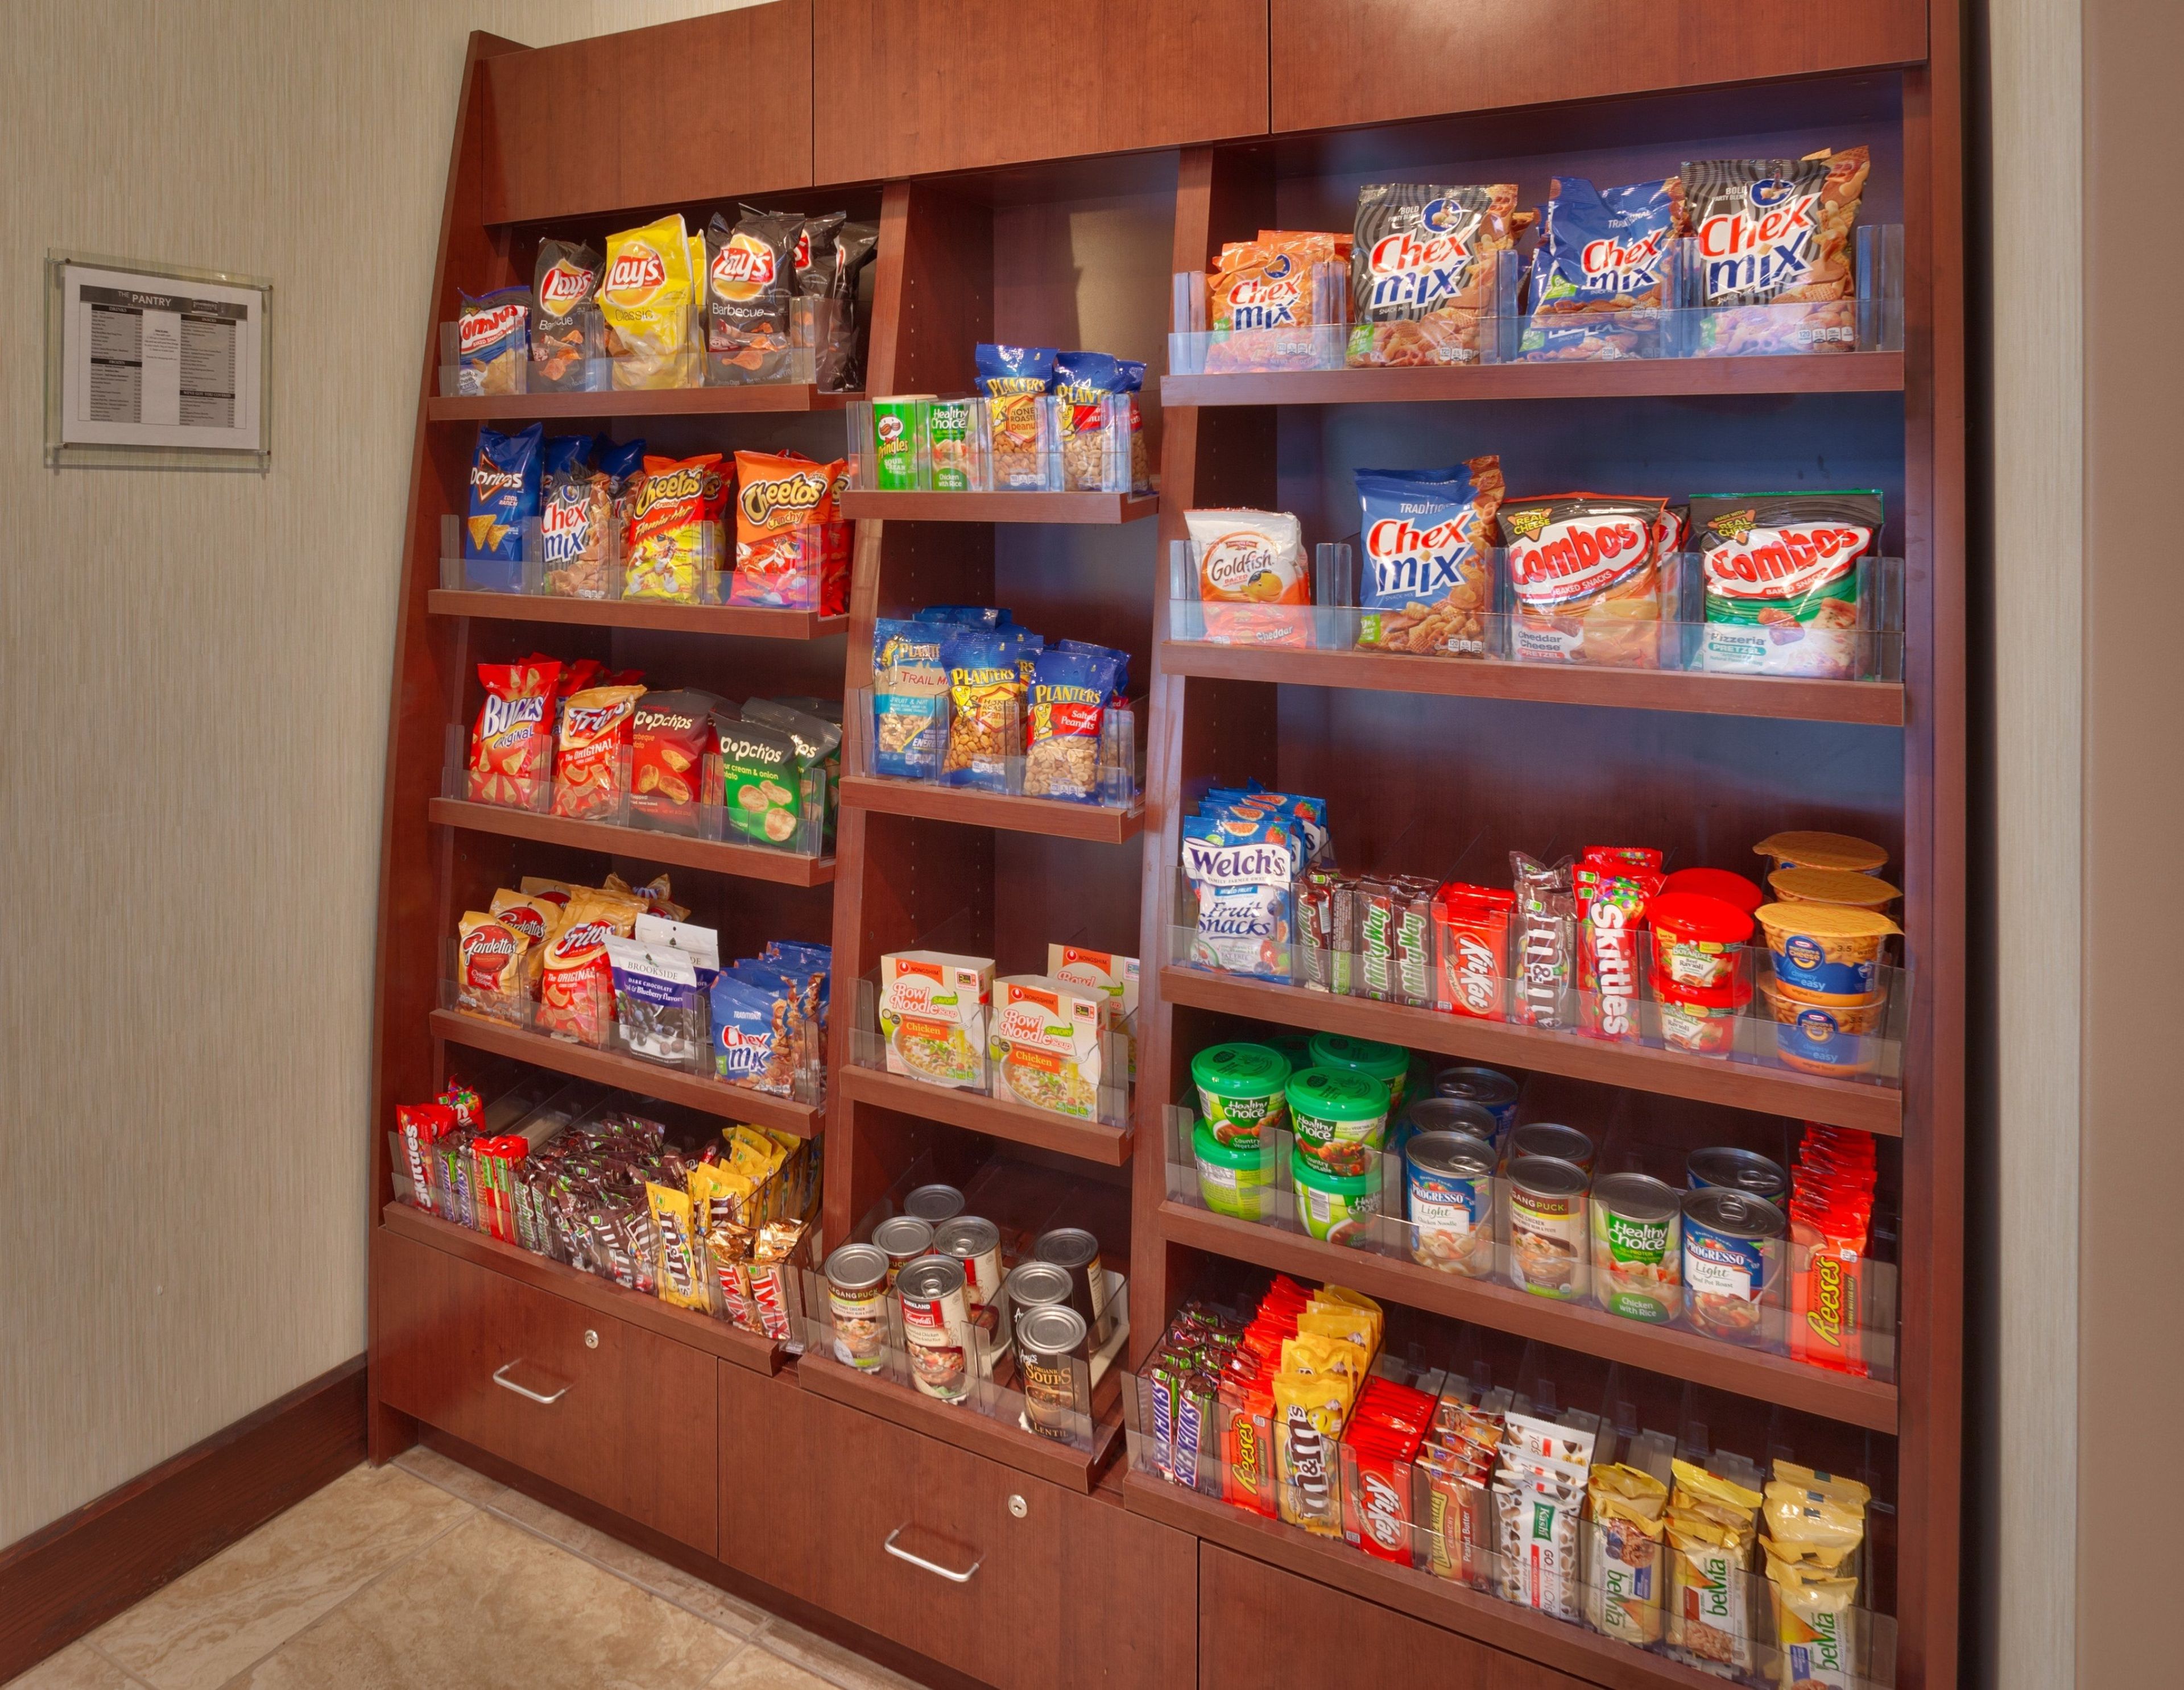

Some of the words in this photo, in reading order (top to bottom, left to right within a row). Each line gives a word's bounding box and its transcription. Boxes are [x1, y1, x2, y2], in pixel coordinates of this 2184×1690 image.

[1725, 185, 1748, 195] BOLD
[1399, 205, 1420, 216] BOLD
[1700, 197, 1813, 257] Chex
[1372, 219, 1480, 274] Chex
[1583, 230, 1663, 274] Chex
[713, 249, 771, 283] Lay's
[1709, 230, 1810, 293] mix
[607, 256, 660, 291] Lay's
[1373, 259, 1467, 305] mix
[1589, 256, 1662, 290] mix
[544, 268, 593, 301] Lay's
[1228, 273, 1302, 305] Chex
[132, 294, 172, 307] PANTRY
[712, 303, 765, 317] Barbecue
[615, 308, 653, 322] Classic
[1235, 293, 1301, 331] mix
[987, 378, 1046, 397] PLANTERS
[933, 406, 969, 420] Healthy
[931, 417, 966, 429] Choice
[878, 437, 909, 464] Pringles
[470, 467, 523, 488] Doritos
[634, 469, 703, 517] Cheetos
[743, 473, 825, 524] Cheetos
[655, 500, 679, 508] Crunchy
[541, 499, 589, 533] Chex
[768, 511, 803, 529] Crunchy
[1516, 513, 1544, 526] REAL
[1719, 517, 1751, 529] REAL
[1729, 510, 1745, 518] WITH
[1369, 513, 1469, 557] Chex
[1513, 518, 1551, 535] CHEESE
[545, 525, 588, 560] mix
[1509, 523, 1639, 585] Combos
[1711, 529, 1860, 583] Combos
[1211, 549, 1272, 582] Goldfish
[1378, 548, 1466, 594] mix
[1224, 574, 1248, 584] BAKED
[1554, 585, 1581, 595] BAKED
[1583, 571, 1613, 590] SNACKS
[1256, 626, 1293, 641] Cheddar
[1518, 630, 1562, 643] Cheddar
[1710, 632, 1765, 646] Pizzeria
[1520, 640, 1561, 651] Cheese
[1521, 649, 1561, 658] PRETZEL
[1713, 644, 1760, 655] PRETZEL
[901, 671, 935, 686] TRAIL
[952, 668, 1015, 685] PLANTERS
[1035, 685, 1101, 705] PLANTERS
[633, 711, 693, 731] popchips
[1061, 716, 1095, 731] Peanuts
[1072, 710, 1098, 721] Salted
[574, 739, 613, 761] ORIGINAL
[721, 736, 782, 764] popchips
[732, 766, 752, 775] cream
[759, 771, 779, 781] onion
[1188, 847, 1285, 877] Welch's
[1207, 901, 1263, 918] Fruit
[1197, 913, 1271, 936] Snacks
[555, 922, 616, 956] Fritos
[462, 933, 519, 966] Gardetto's
[1078, 955, 1108, 965] NONGSHIM
[1590, 902, 1633, 1035] Skittles
[557, 968, 597, 983] ORIGINAL
[627, 962, 679, 980] BROOKSIDE
[911, 967, 940, 976] NONGSHIM
[637, 987, 663, 1001] Blueberry
[643, 981, 673, 992] CHOCOLATE
[893, 983, 930, 1000] Bowl
[1801, 978, 1826, 991] easy
[890, 995, 939, 1014] Noodle
[1024, 995, 1054, 1005] NONGSHIM
[905, 1022, 941, 1035] Chicken
[1004, 1009, 1044, 1030] Bowl
[722, 1025, 770, 1047] Chex
[1000, 1022, 1052, 1045] Noodle
[1046, 1027, 1073, 1035] SAVORY
[729, 1046, 768, 1071] mix
[1015, 1050, 1053, 1067] Chicken
[1813, 1051, 1838, 1064] easy
[1223, 1106, 1265, 1119] Choice
[1228, 1099, 1268, 1110] Healthy
[1296, 1119, 1331, 1141] Choice
[1297, 1113, 1334, 1132] Healthy
[406, 1124, 432, 1208] Skittles
[1411, 1184, 1464, 1204] PROGRESSO
[1421, 1204, 1451, 1217] Light
[1536, 1201, 1565, 1211] PUCK
[1613, 1220, 1668, 1238] Healthy
[1608, 1228, 1666, 1251] Choice
[1686, 1239, 1745, 1266] PROGRESSO
[1695, 1261, 1729, 1278] Light
[1706, 1278, 1715, 1287] Pot
[1715, 1279, 1734, 1289] Roast
[858, 1288, 878, 1299] PUCK
[1806, 1255, 1841, 1347] Reese's
[1619, 1304, 1639, 1316] with
[1639, 1307, 1657, 1318] Rice
[1622, 1297, 1653, 1310] Chicken
[1024, 1362, 1072, 1385] SOUPS
[1034, 1423, 1068, 1438] LENTIL
[1231, 1418, 1258, 1496] Reese's
[1432, 1493, 1446, 1528] VALLEY
[1538, 1507, 1550, 1538] Kashi
[1462, 1535, 1472, 1563] Peanut
[1707, 1558, 1730, 1617] belVita
[1606, 1568, 1629, 1627] belVita
[1815, 1612, 1840, 1671] belVita
